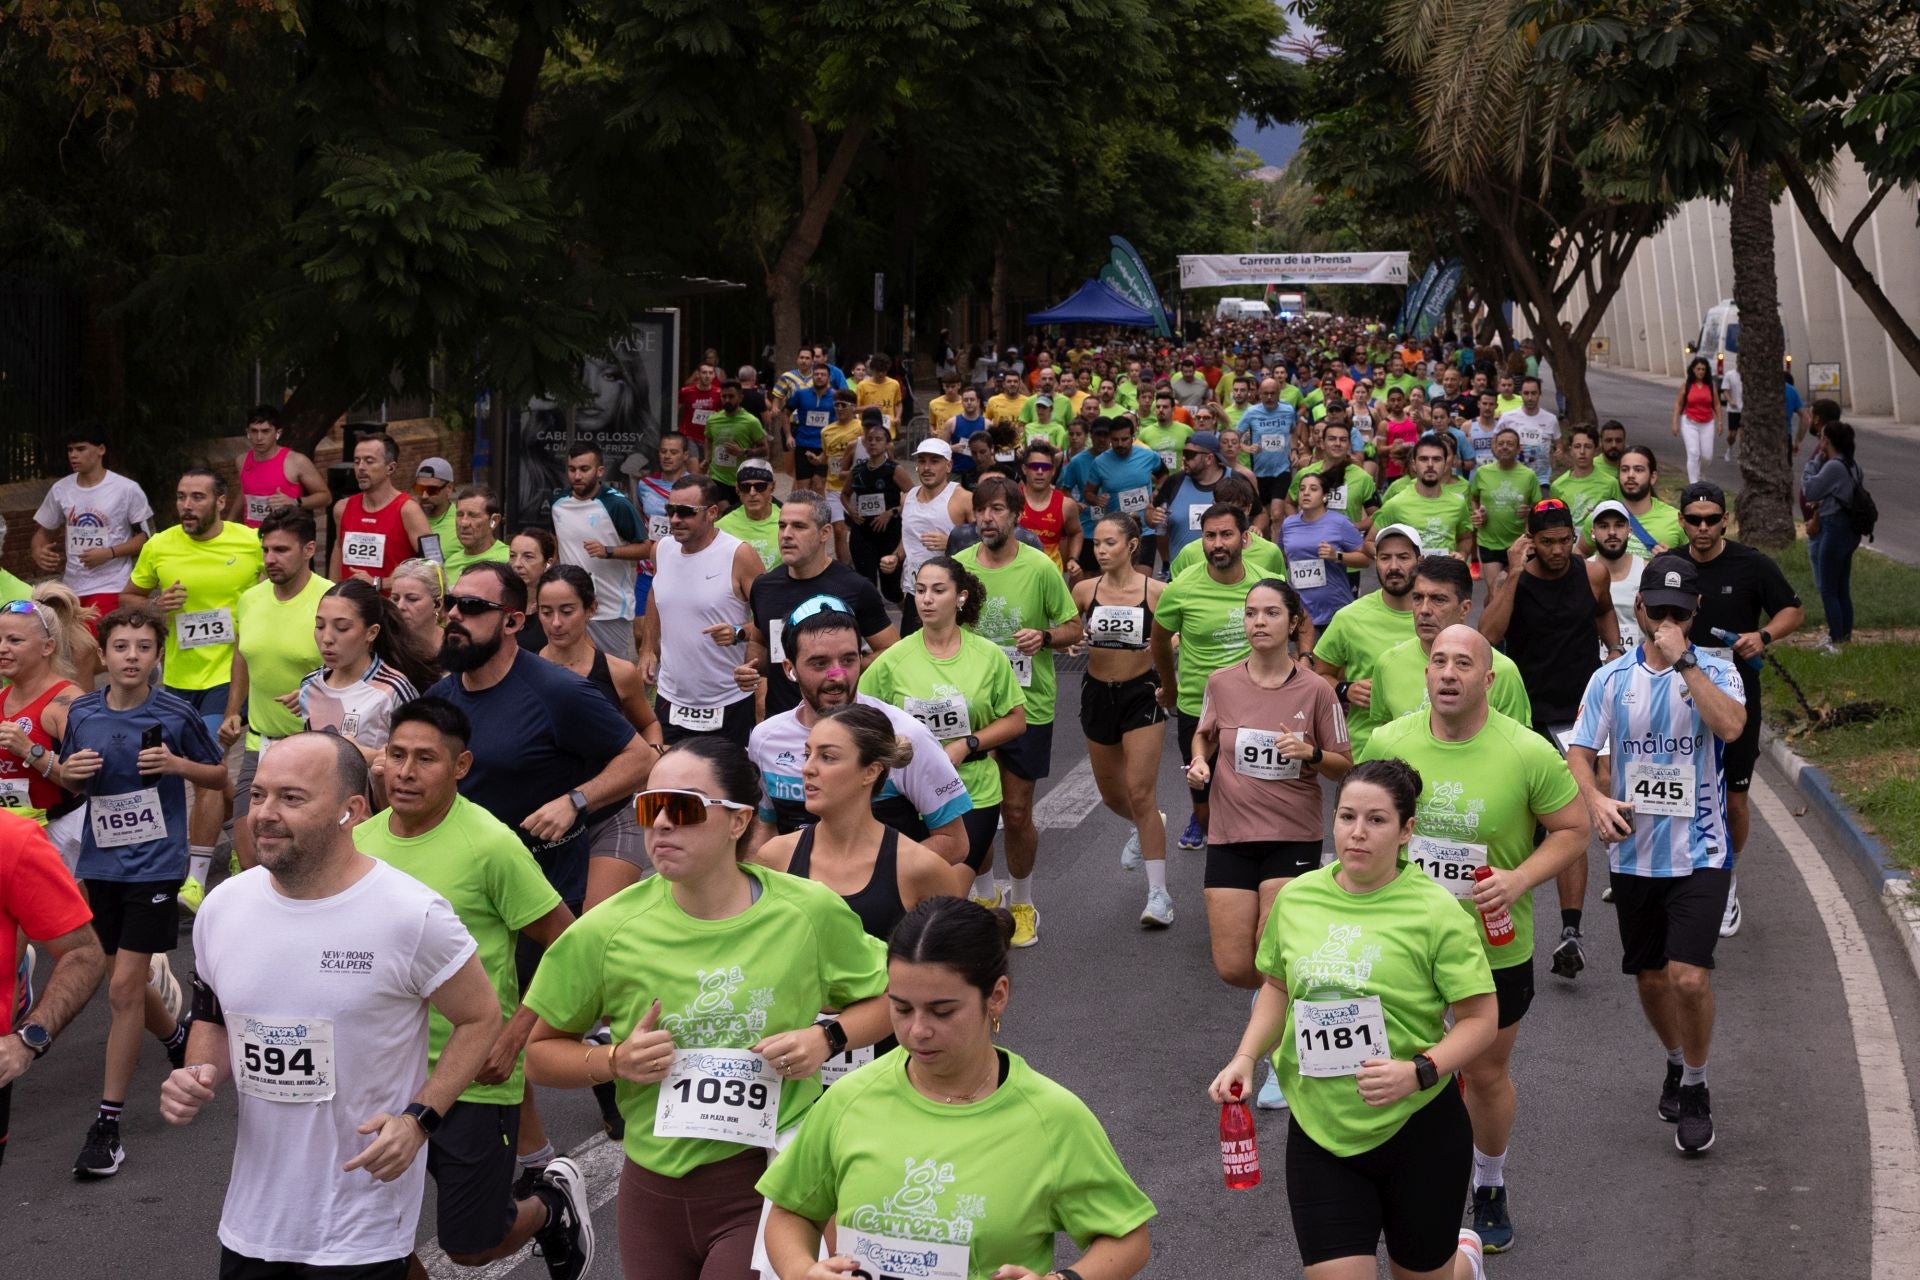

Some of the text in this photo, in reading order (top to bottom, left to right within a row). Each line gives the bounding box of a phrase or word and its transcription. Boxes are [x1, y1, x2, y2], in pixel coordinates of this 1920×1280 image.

[1240, 256, 1282, 265] Carrera
[1284, 256, 1297, 265] de
[1314, 255, 1352, 264] Prensa
[1259, 418, 1286, 428] nerja
[596, 432, 644, 442] GLOSSY
[1520, 432, 1540, 440] 1107
[861, 501, 881, 510] 205
[1123, 494, 1145, 506] 544
[250, 503, 272, 514] 564
[72, 537, 104, 547] 1773
[348, 544, 377, 557] 622
[1294, 568, 1321, 579] 1074
[185, 621, 224, 638] 713
[1098, 619, 1134, 632] 323
[677, 706, 714, 719] 489
[1634, 779, 1684, 800] 445
[97, 807, 155, 831] 1694
[1414, 857, 1476, 881] 1182
[321, 950, 375, 961] NEW ROADS
[320, 959, 373, 970] SCALPERS
[1301, 1024, 1372, 1051] 1181
[244, 1043, 315, 1076] 594
[672, 1077, 768, 1111] 1039
[710, 1114, 726, 1122] PLAZA,
[1238, 1138, 1253, 1152] TU
[1231, 1163, 1243, 1175] TE
[853, 1203, 950, 1239] Carrera
[868, 1243, 925, 1266] Carrera
